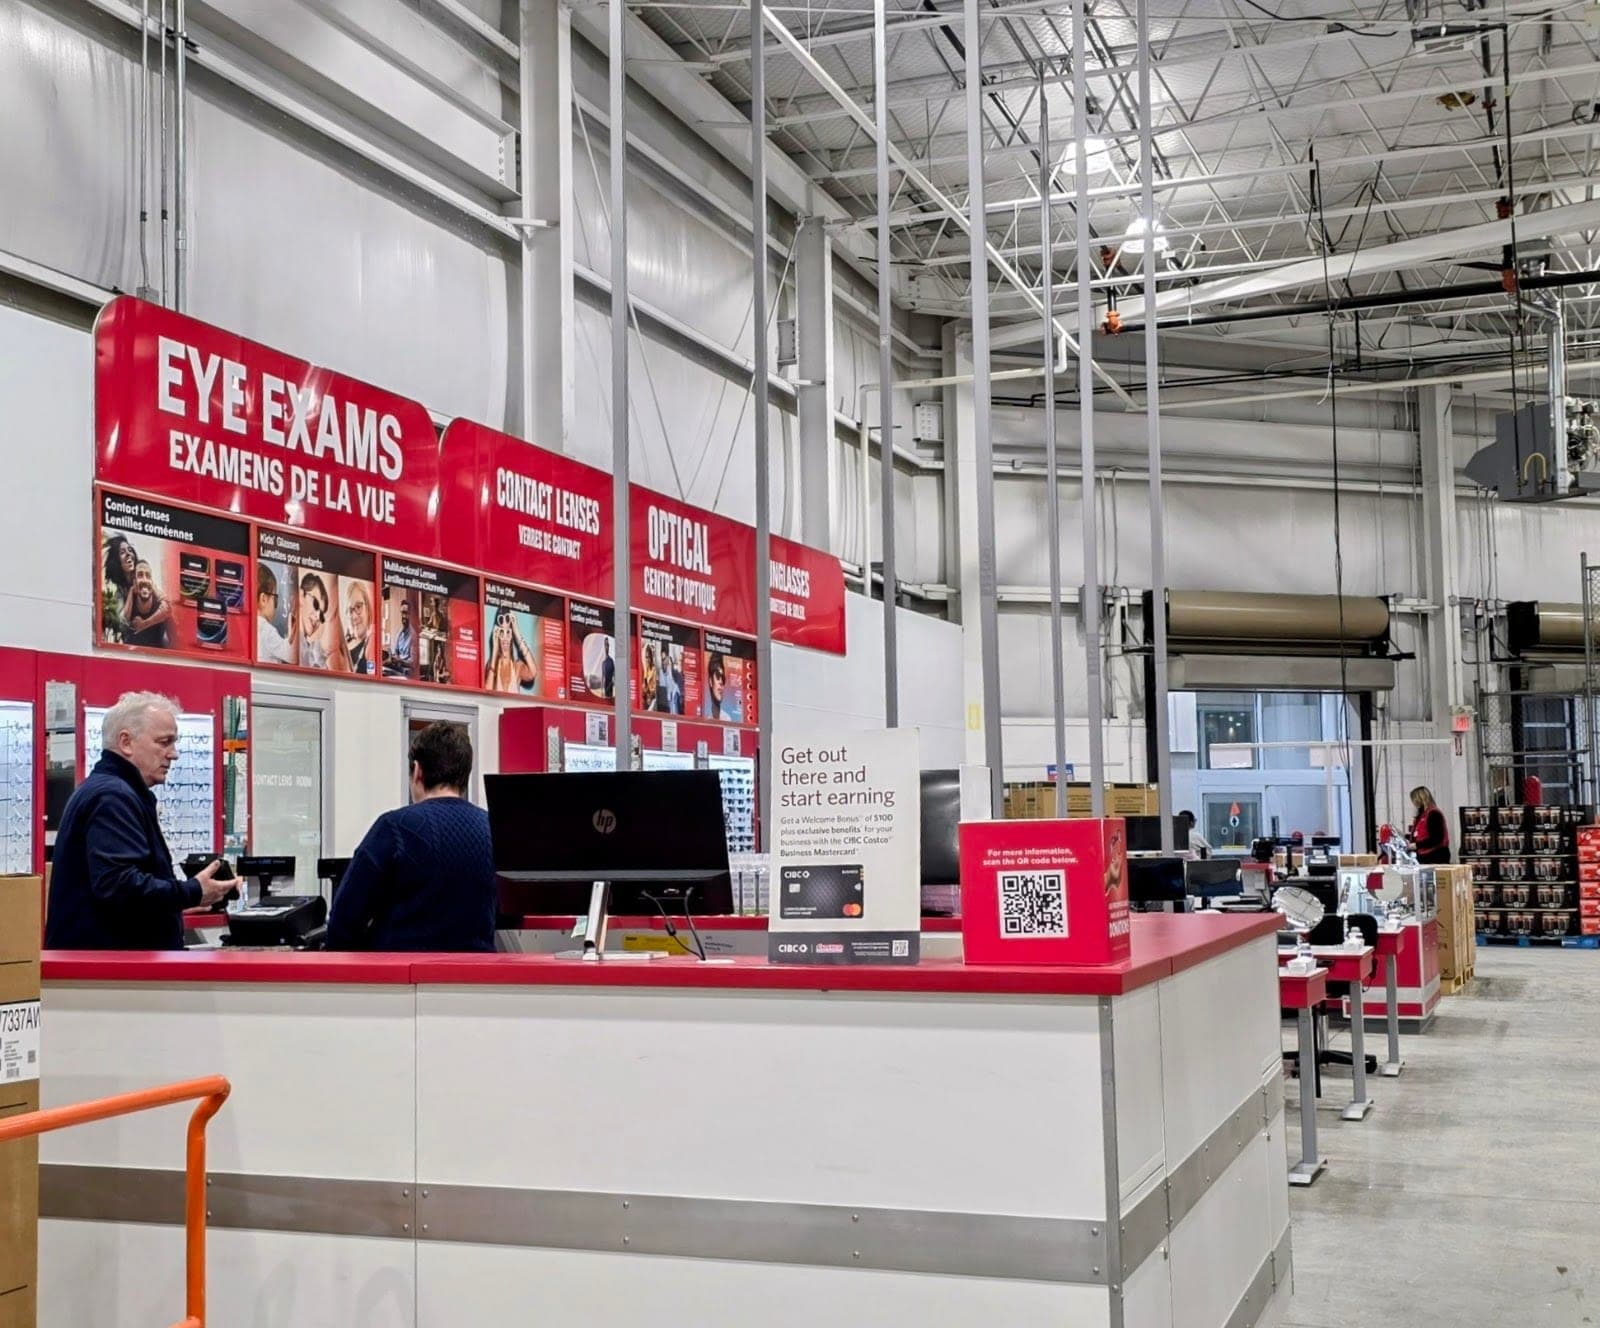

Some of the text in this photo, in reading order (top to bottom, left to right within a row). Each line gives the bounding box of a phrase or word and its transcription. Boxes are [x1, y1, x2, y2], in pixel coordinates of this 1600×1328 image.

[157, 335, 403, 481] EYE EXAMS
[169, 429, 396, 525] EXAMENS DE LA VUE
[105, 497, 170, 523] Contact Lenses
[496, 466, 600, 536] CONTACT LENSES
[105, 512, 194, 541] Lentilles cornéennes
[518, 523, 582, 560] VERRES DE CONTACT
[647, 505, 712, 576] OPTICAL
[644, 566, 716, 615] CENTRE D'OPTIQUE
[781, 746, 847, 764] Get out
[782, 765, 866, 785] there and
[781, 787, 895, 807] start earning
[594, 809, 616, 835] hp
[781, 816, 795, 825] Get
[802, 815, 835, 824] Welcome
[873, 814, 893, 822] $100
[781, 827, 796, 836] plus
[797, 827, 830, 835] exclusive
[831, 825, 861, 834] benefits
[876, 826, 893, 834] your
[781, 836, 889, 846] business with the CIBC Costco
[781, 848, 856, 857] Business Mastercard
[987, 849, 1001, 857] For
[1025, 847, 1072, 856] information,
[1002, 858, 1015, 866] the
[1017, 857, 1029, 866] QR
[1031, 857, 1050, 865] code
[1052, 856, 1079, 865] below.
[778, 944, 799, 953] CIBC
[0, 1006, 41, 1032] 7337AW
